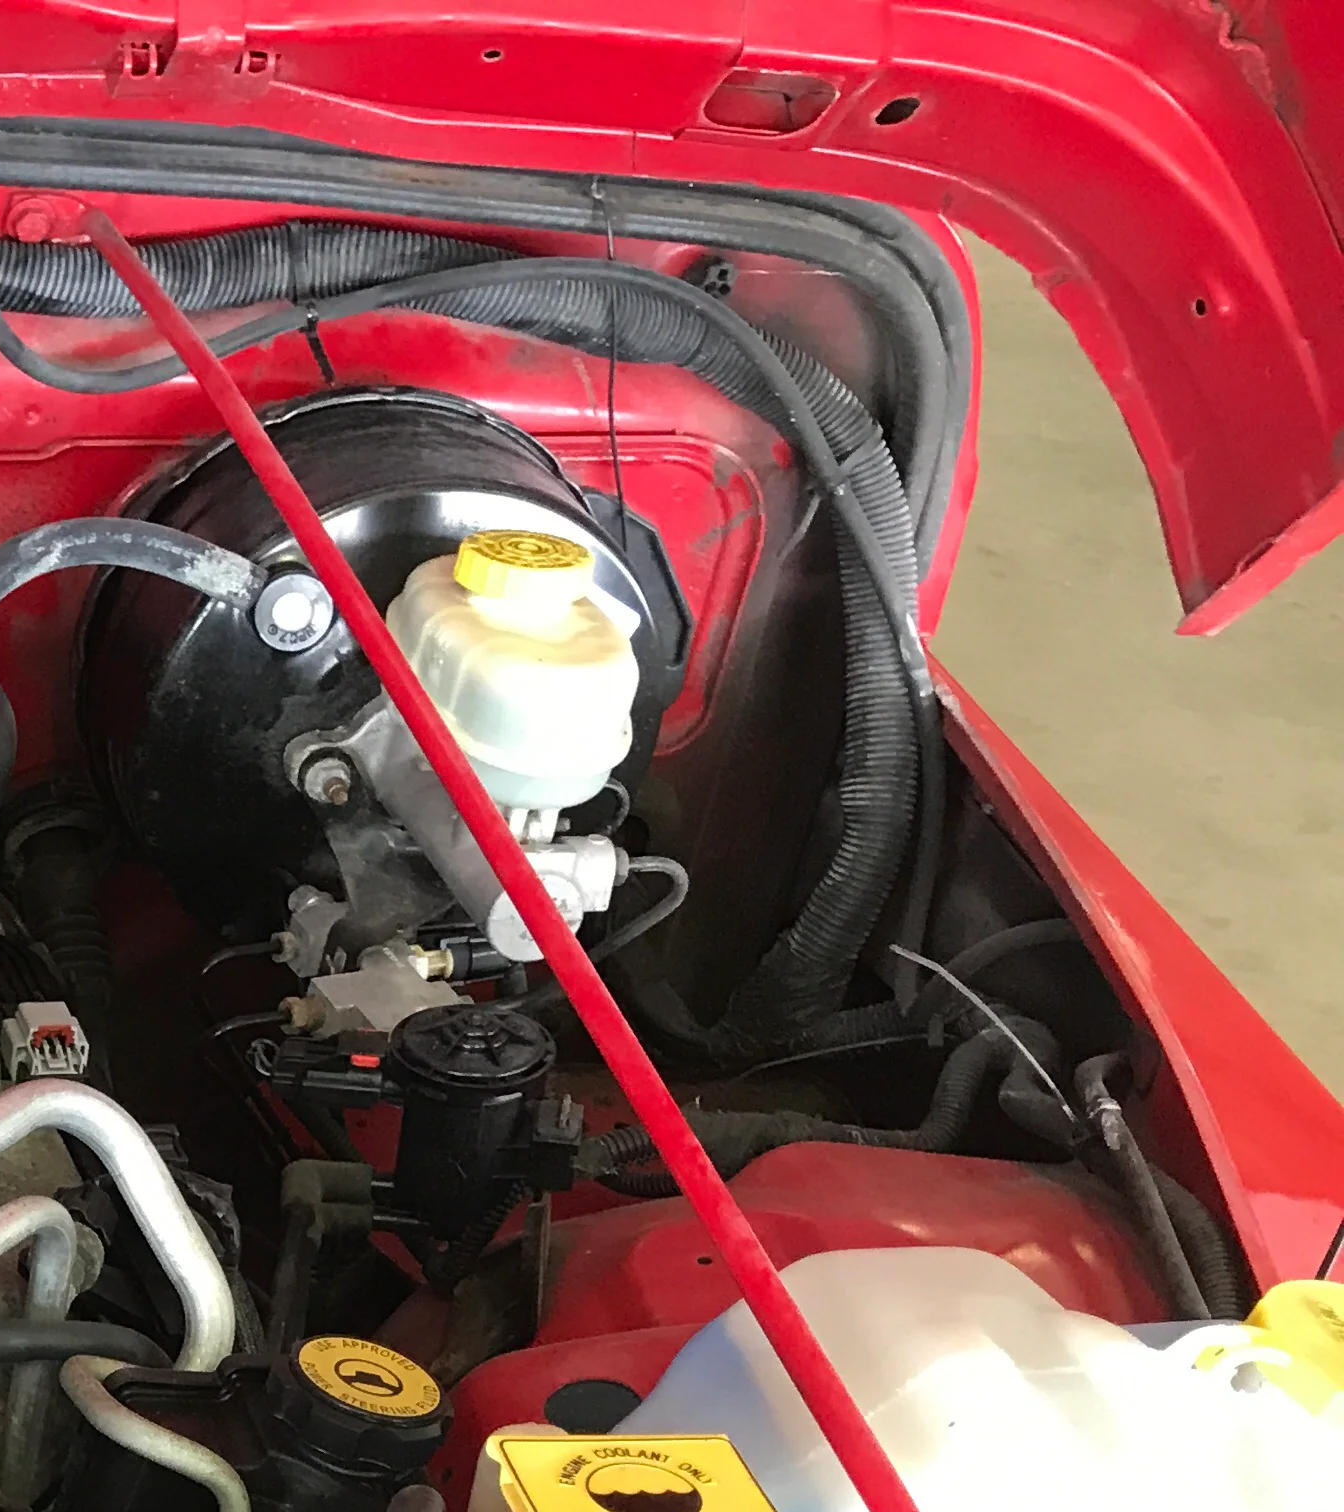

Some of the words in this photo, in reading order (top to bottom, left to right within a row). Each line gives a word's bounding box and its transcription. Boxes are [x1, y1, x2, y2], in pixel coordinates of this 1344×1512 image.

[311, 1339, 337, 1353] USE
[341, 1339, 416, 1372] APPROVED
[300, 1361, 334, 1391] POWER
[338, 1392, 417, 1416] STEERING
[415, 1384, 438, 1411] FLUID
[558, 1454, 592, 1487] ENGINE
[592, 1447, 671, 1465] COOLANT
[678, 1462, 716, 1486] ONLY
